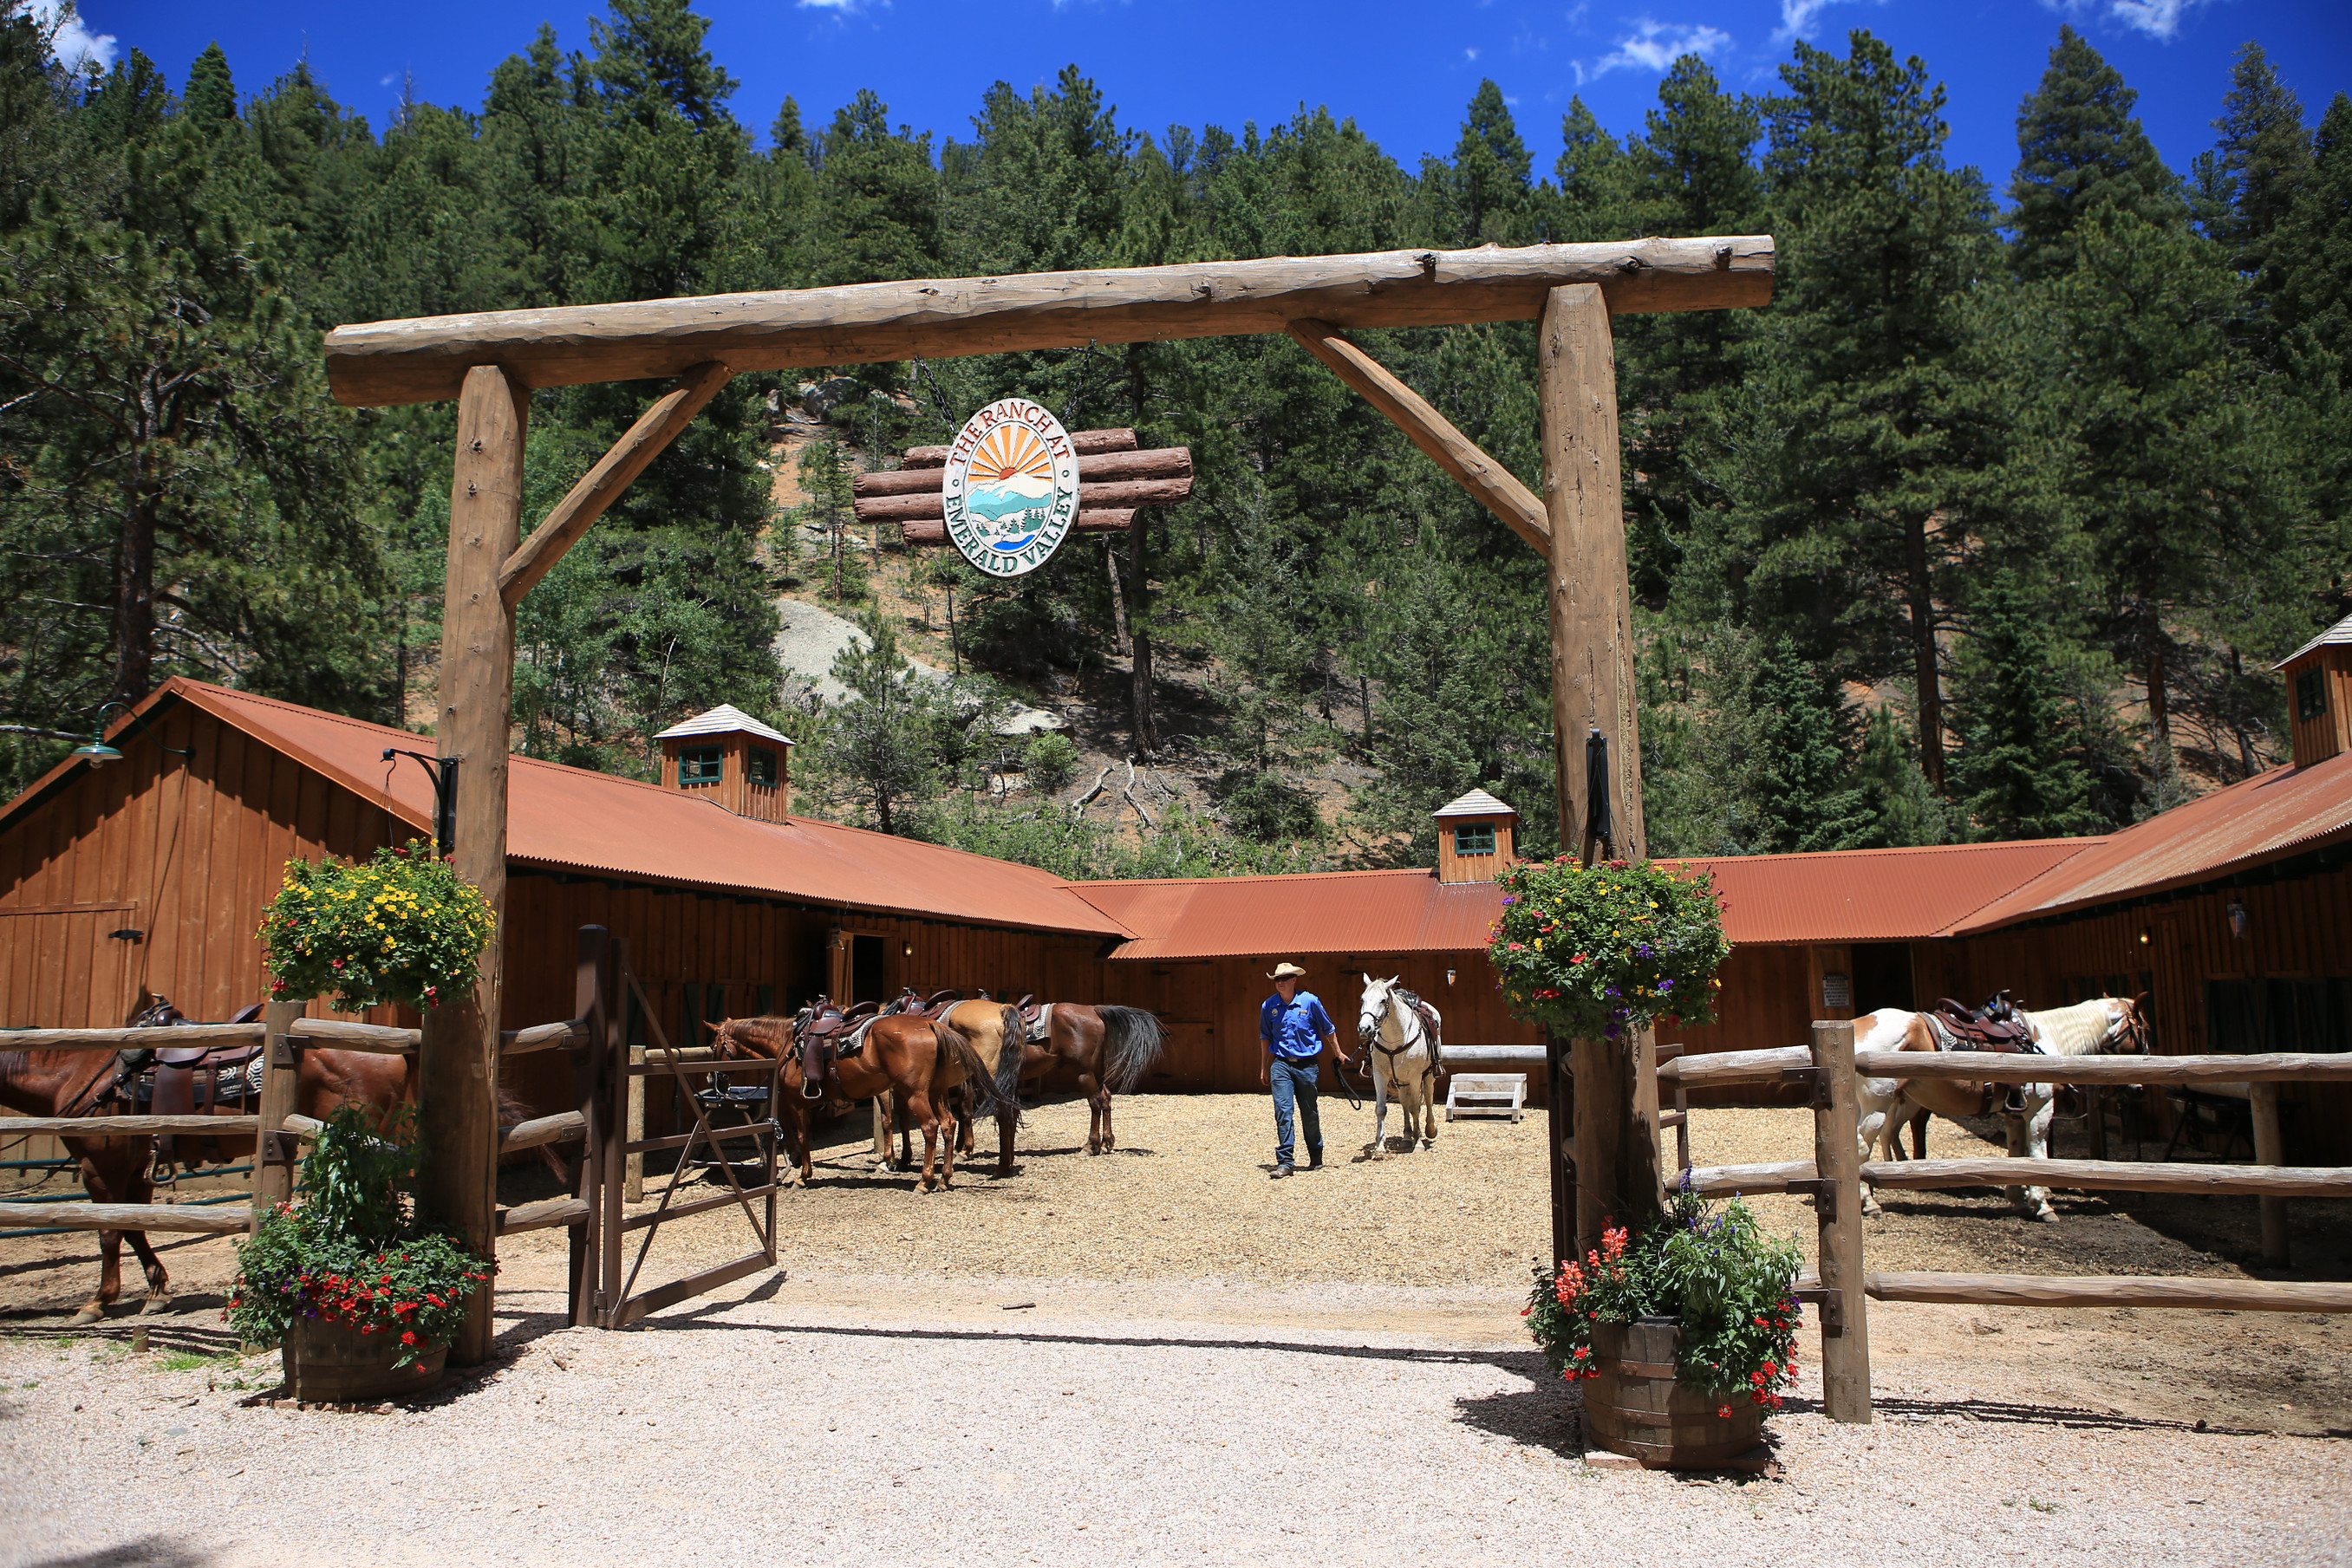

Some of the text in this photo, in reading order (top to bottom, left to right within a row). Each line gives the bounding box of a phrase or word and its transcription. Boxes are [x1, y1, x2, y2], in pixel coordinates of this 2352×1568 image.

[949, 401, 1071, 466] THE RANCH AT
[946, 486, 1073, 573] EMERALD VALLEY
